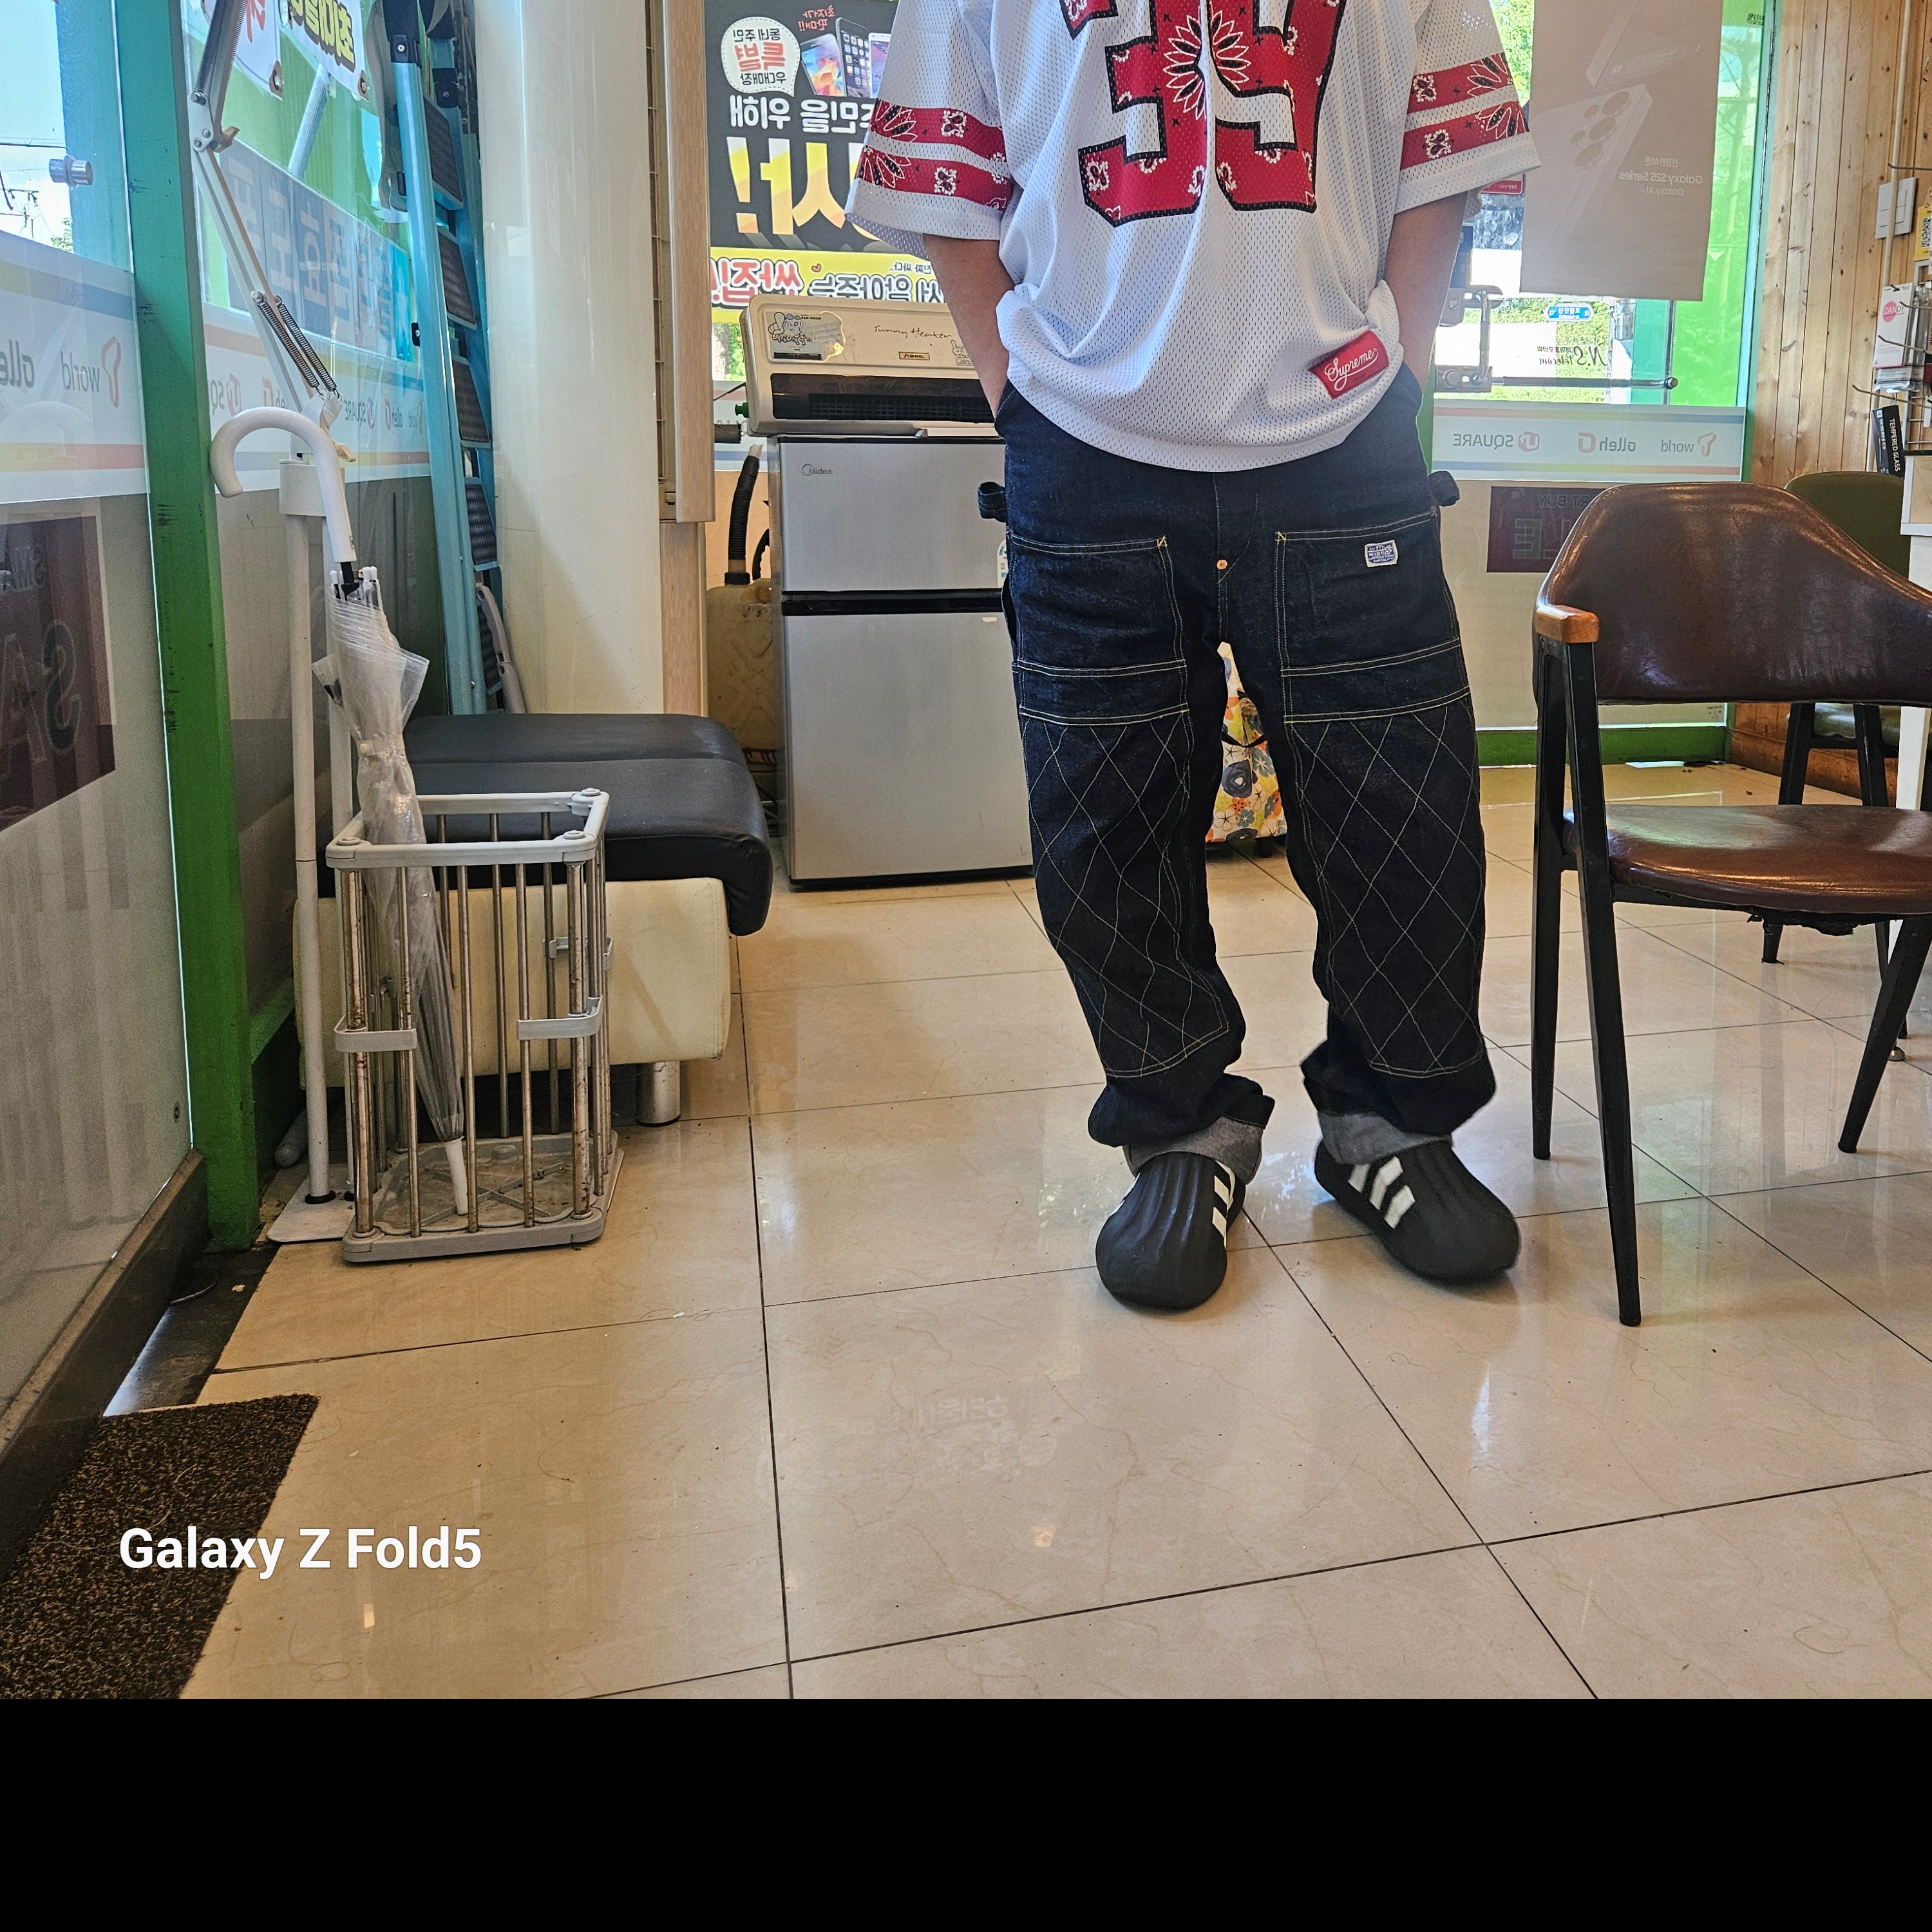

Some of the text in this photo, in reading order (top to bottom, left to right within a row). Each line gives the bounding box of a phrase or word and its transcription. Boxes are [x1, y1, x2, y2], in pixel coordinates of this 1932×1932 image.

[875, 325, 952, 339] Sunny Heater
[1324, 349, 1379, 392] Supreme
[1889, 418, 1899, 451] TEMPERED
[802, 463, 832, 476] Midea
